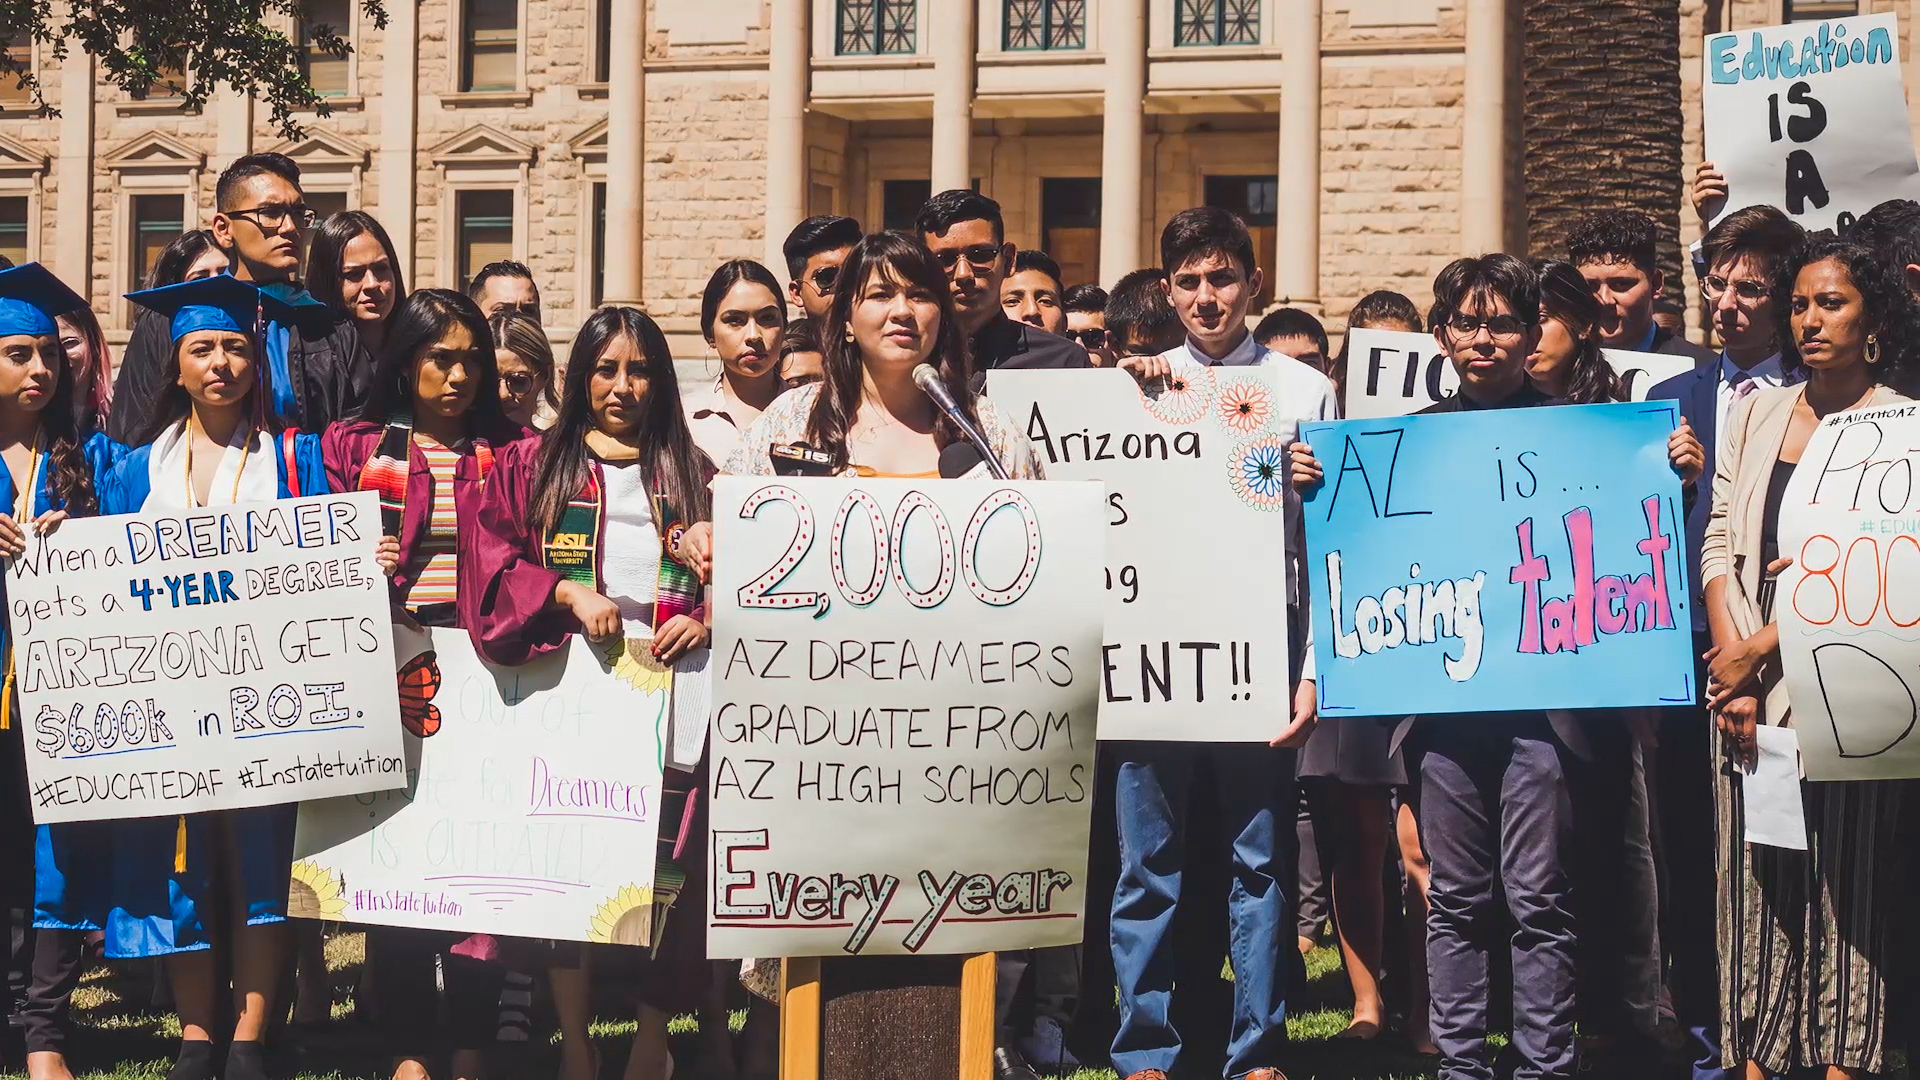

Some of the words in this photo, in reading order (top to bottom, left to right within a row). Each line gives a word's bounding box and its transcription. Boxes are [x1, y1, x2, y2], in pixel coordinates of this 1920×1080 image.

[1710, 22, 1893, 84] Education
[1767, 81, 1828, 143] IS
[1785, 149, 1830, 215] A
[805, 450, 829, 463] 15
[1026, 401, 1201, 464] Arizona
[1327, 428, 1433, 522] AZ
[1808, 421, 1920, 514] Pro
[11, 531, 97, 580] When
[105, 546, 123, 567] a
[126, 501, 361, 565] DREAMER
[551, 533, 588, 550] ASU
[738, 485, 1043, 621] 2,000
[14, 584, 87, 636] gets
[102, 593, 124, 613] a
[130, 569, 240, 611] 4-YEAR
[246, 557, 375, 601] DEGREE,
[1325, 549, 1487, 682] Losing
[23, 623, 264, 694] ARIZONA
[279, 616, 379, 664] GETS
[725, 638, 791, 680] AZ
[809, 639, 1074, 687] DREAMERS
[1101, 641, 1251, 703] ENT!!
[35, 698, 174, 759] $600k
[193, 709, 221, 738] in
[230, 681, 364, 735] ROI.
[717, 702, 933, 749] GRADUATE
[946, 705, 1074, 751] FROM
[34, 768, 225, 809] #EDUCATEDAF
[238, 749, 402, 790] #Instatetuition
[529, 756, 652, 816] Dreamers
[714, 757, 775, 800] AZ
[798, 761, 901, 805] HIGH
[923, 763, 1086, 806] SCHOOLS
[712, 828, 900, 956] Every
[902, 868, 1073, 954] year
